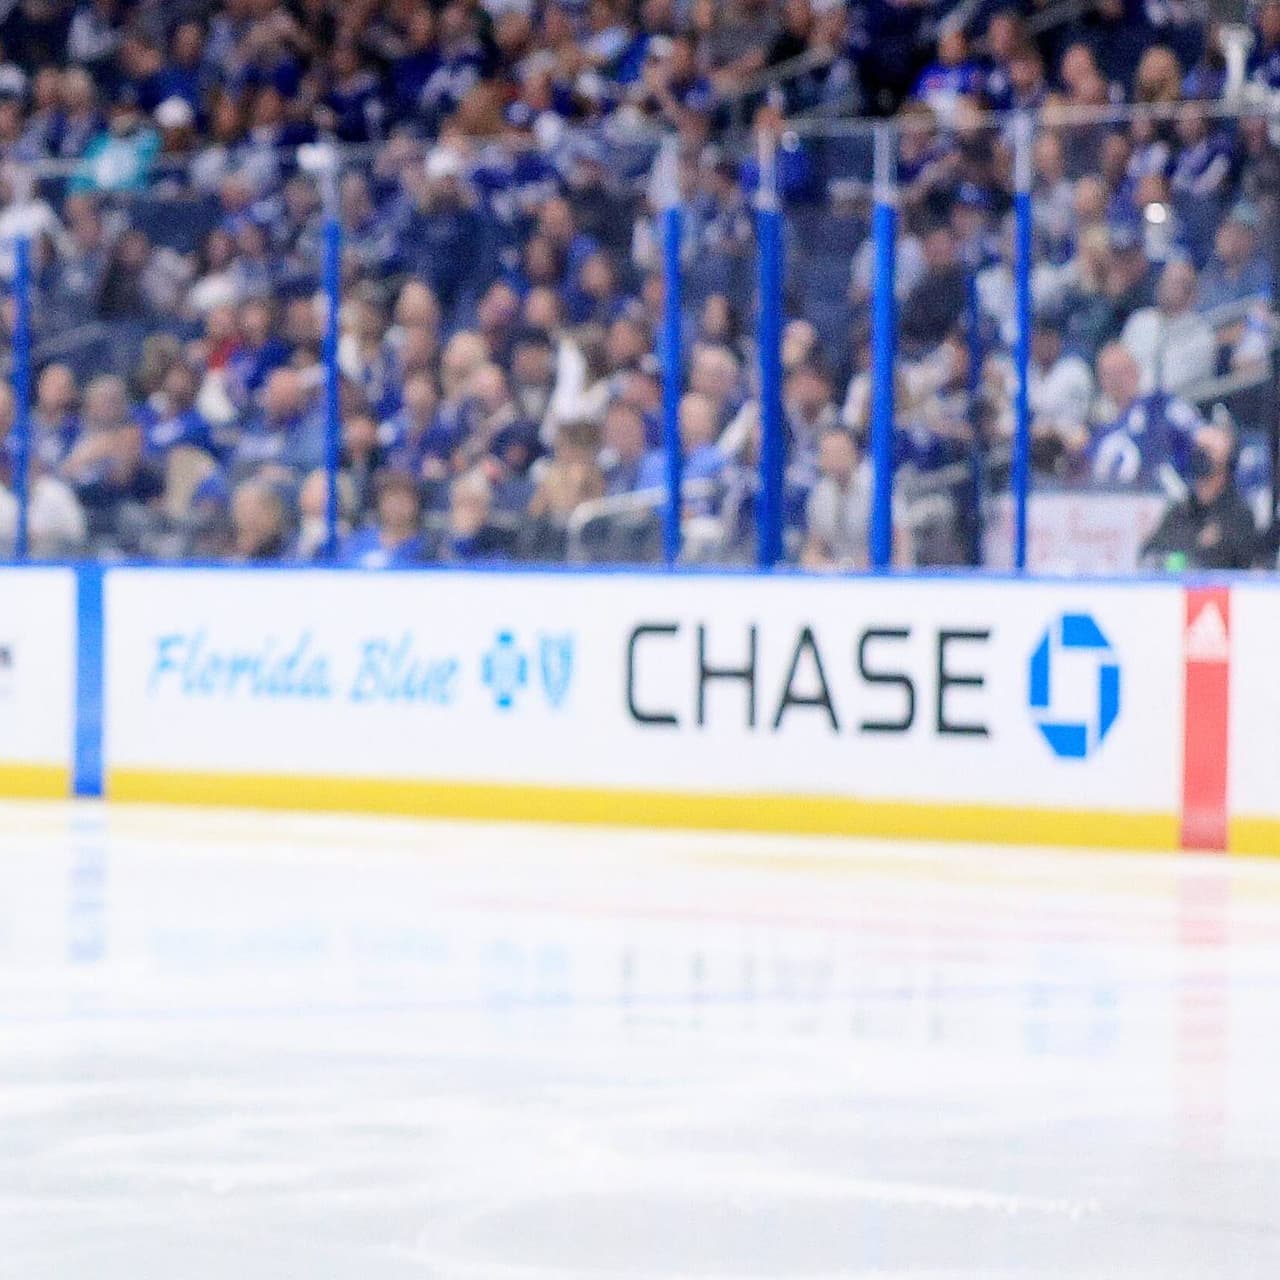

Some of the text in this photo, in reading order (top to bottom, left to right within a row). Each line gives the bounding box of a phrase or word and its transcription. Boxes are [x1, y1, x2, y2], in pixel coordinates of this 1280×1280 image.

[148, 626, 461, 703] Florida Blue
[626, 622, 991, 738] CHASE
